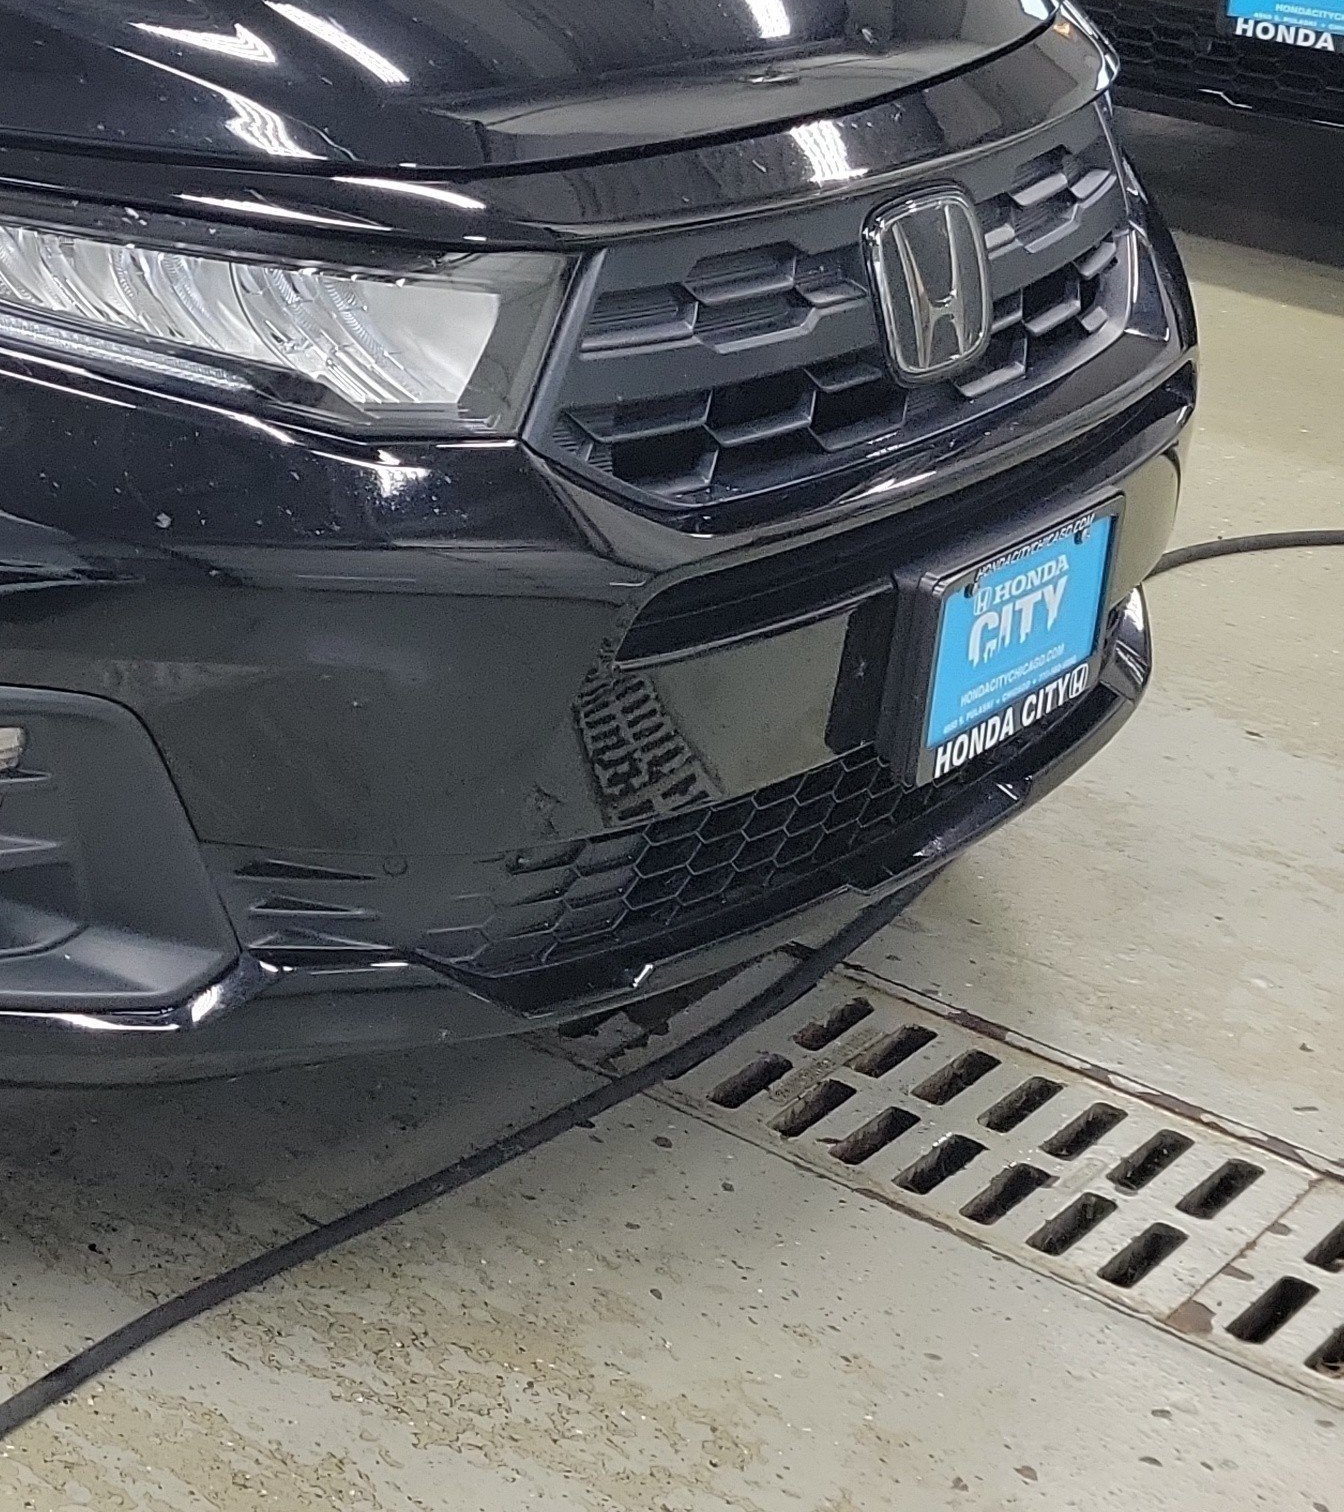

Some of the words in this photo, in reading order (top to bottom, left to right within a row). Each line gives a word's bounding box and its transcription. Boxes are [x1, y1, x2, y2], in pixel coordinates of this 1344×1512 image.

[1235, 17, 1335, 52] HONDA
[993, 554, 1070, 605] HONDA
[968, 575, 1068, 668] CITY
[934, 707, 1014, 778] HONDA
[1021, 673, 1071, 727] CITY
